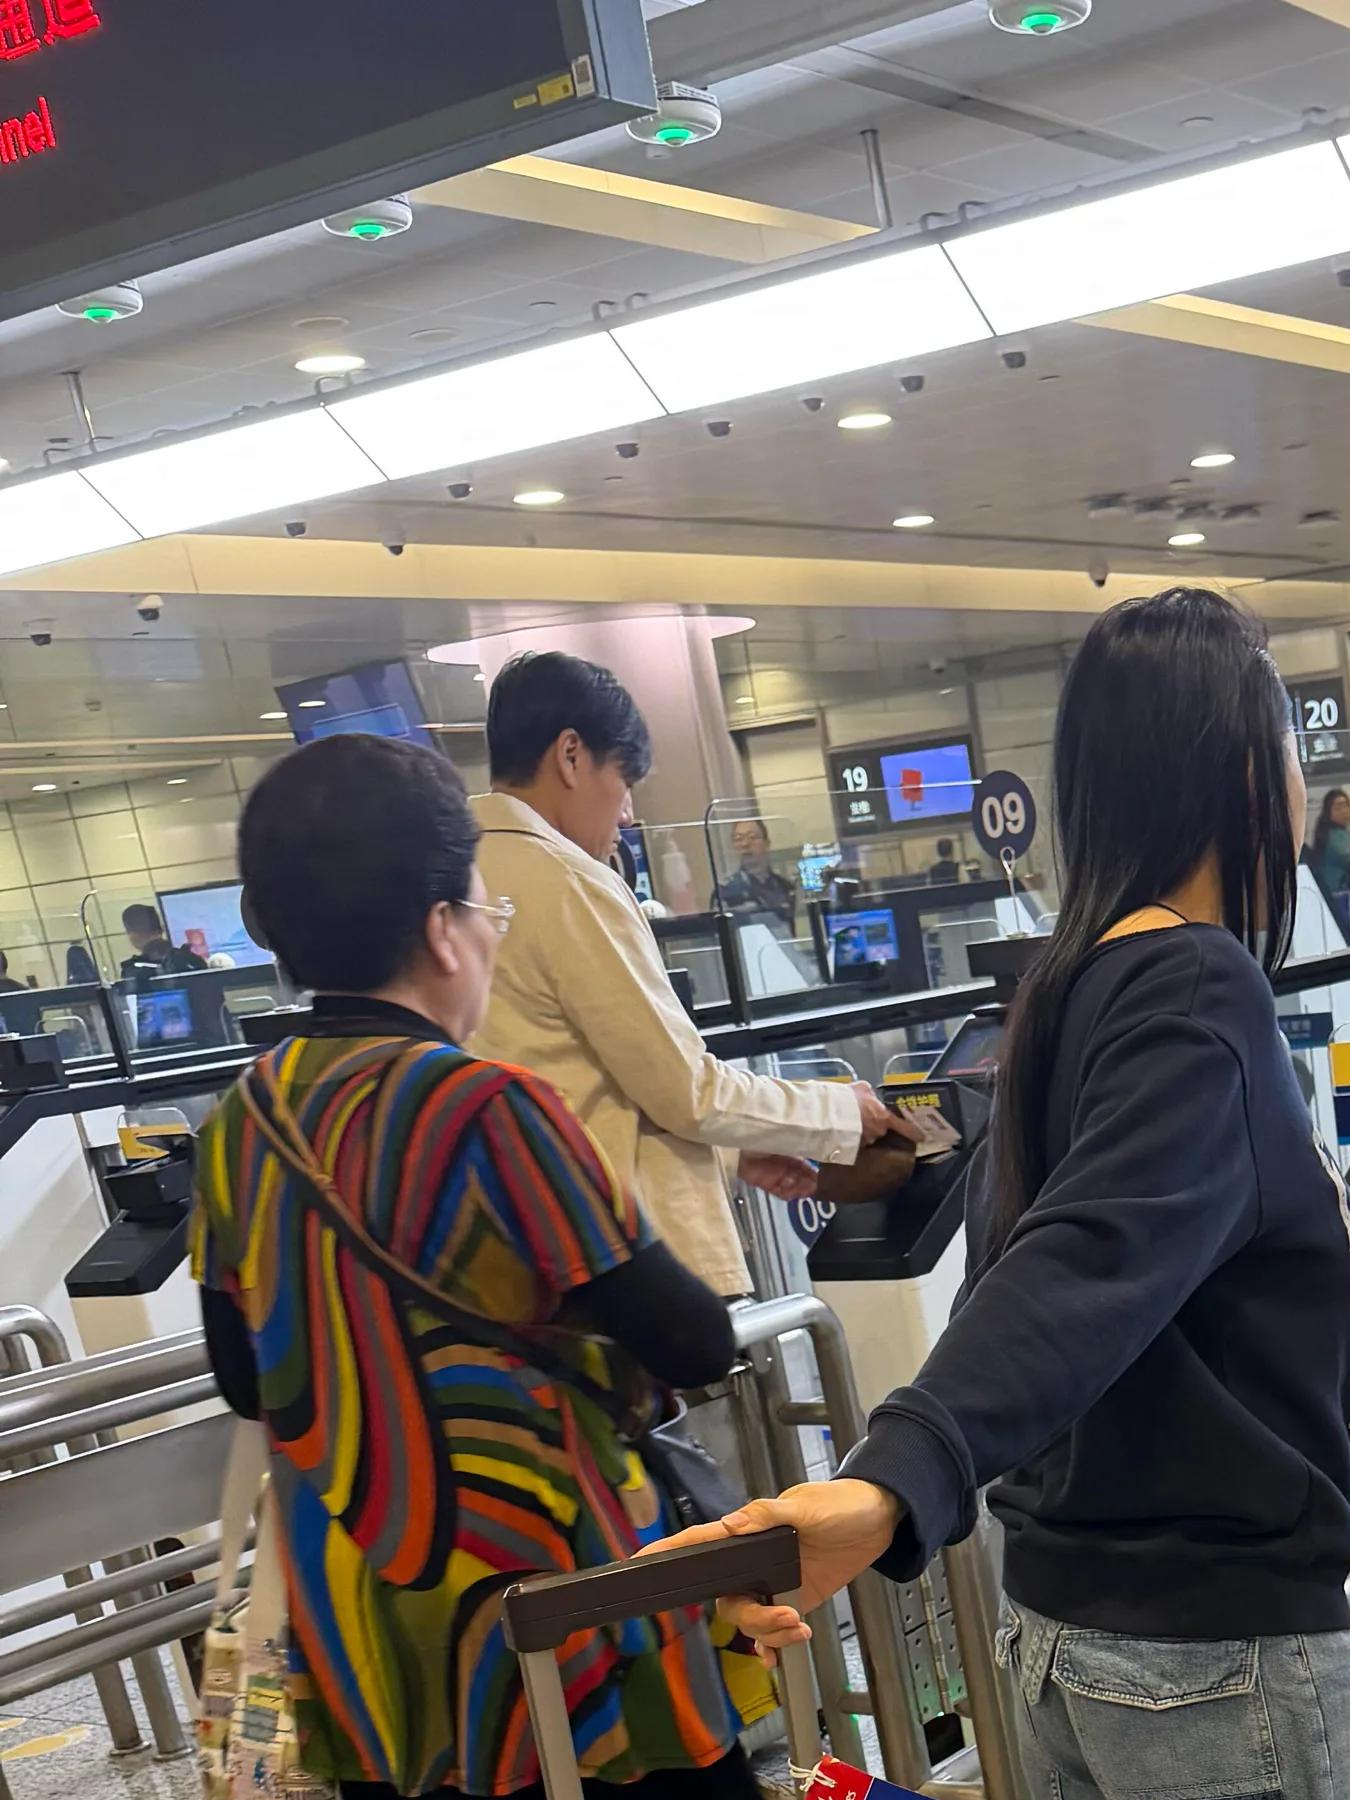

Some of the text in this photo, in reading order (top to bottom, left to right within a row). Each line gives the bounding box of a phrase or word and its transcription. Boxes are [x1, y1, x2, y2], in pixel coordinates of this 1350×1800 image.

[1304, 698, 1339, 730] 20
[842, 766, 868, 793] 19
[981, 791, 1026, 839] 09
